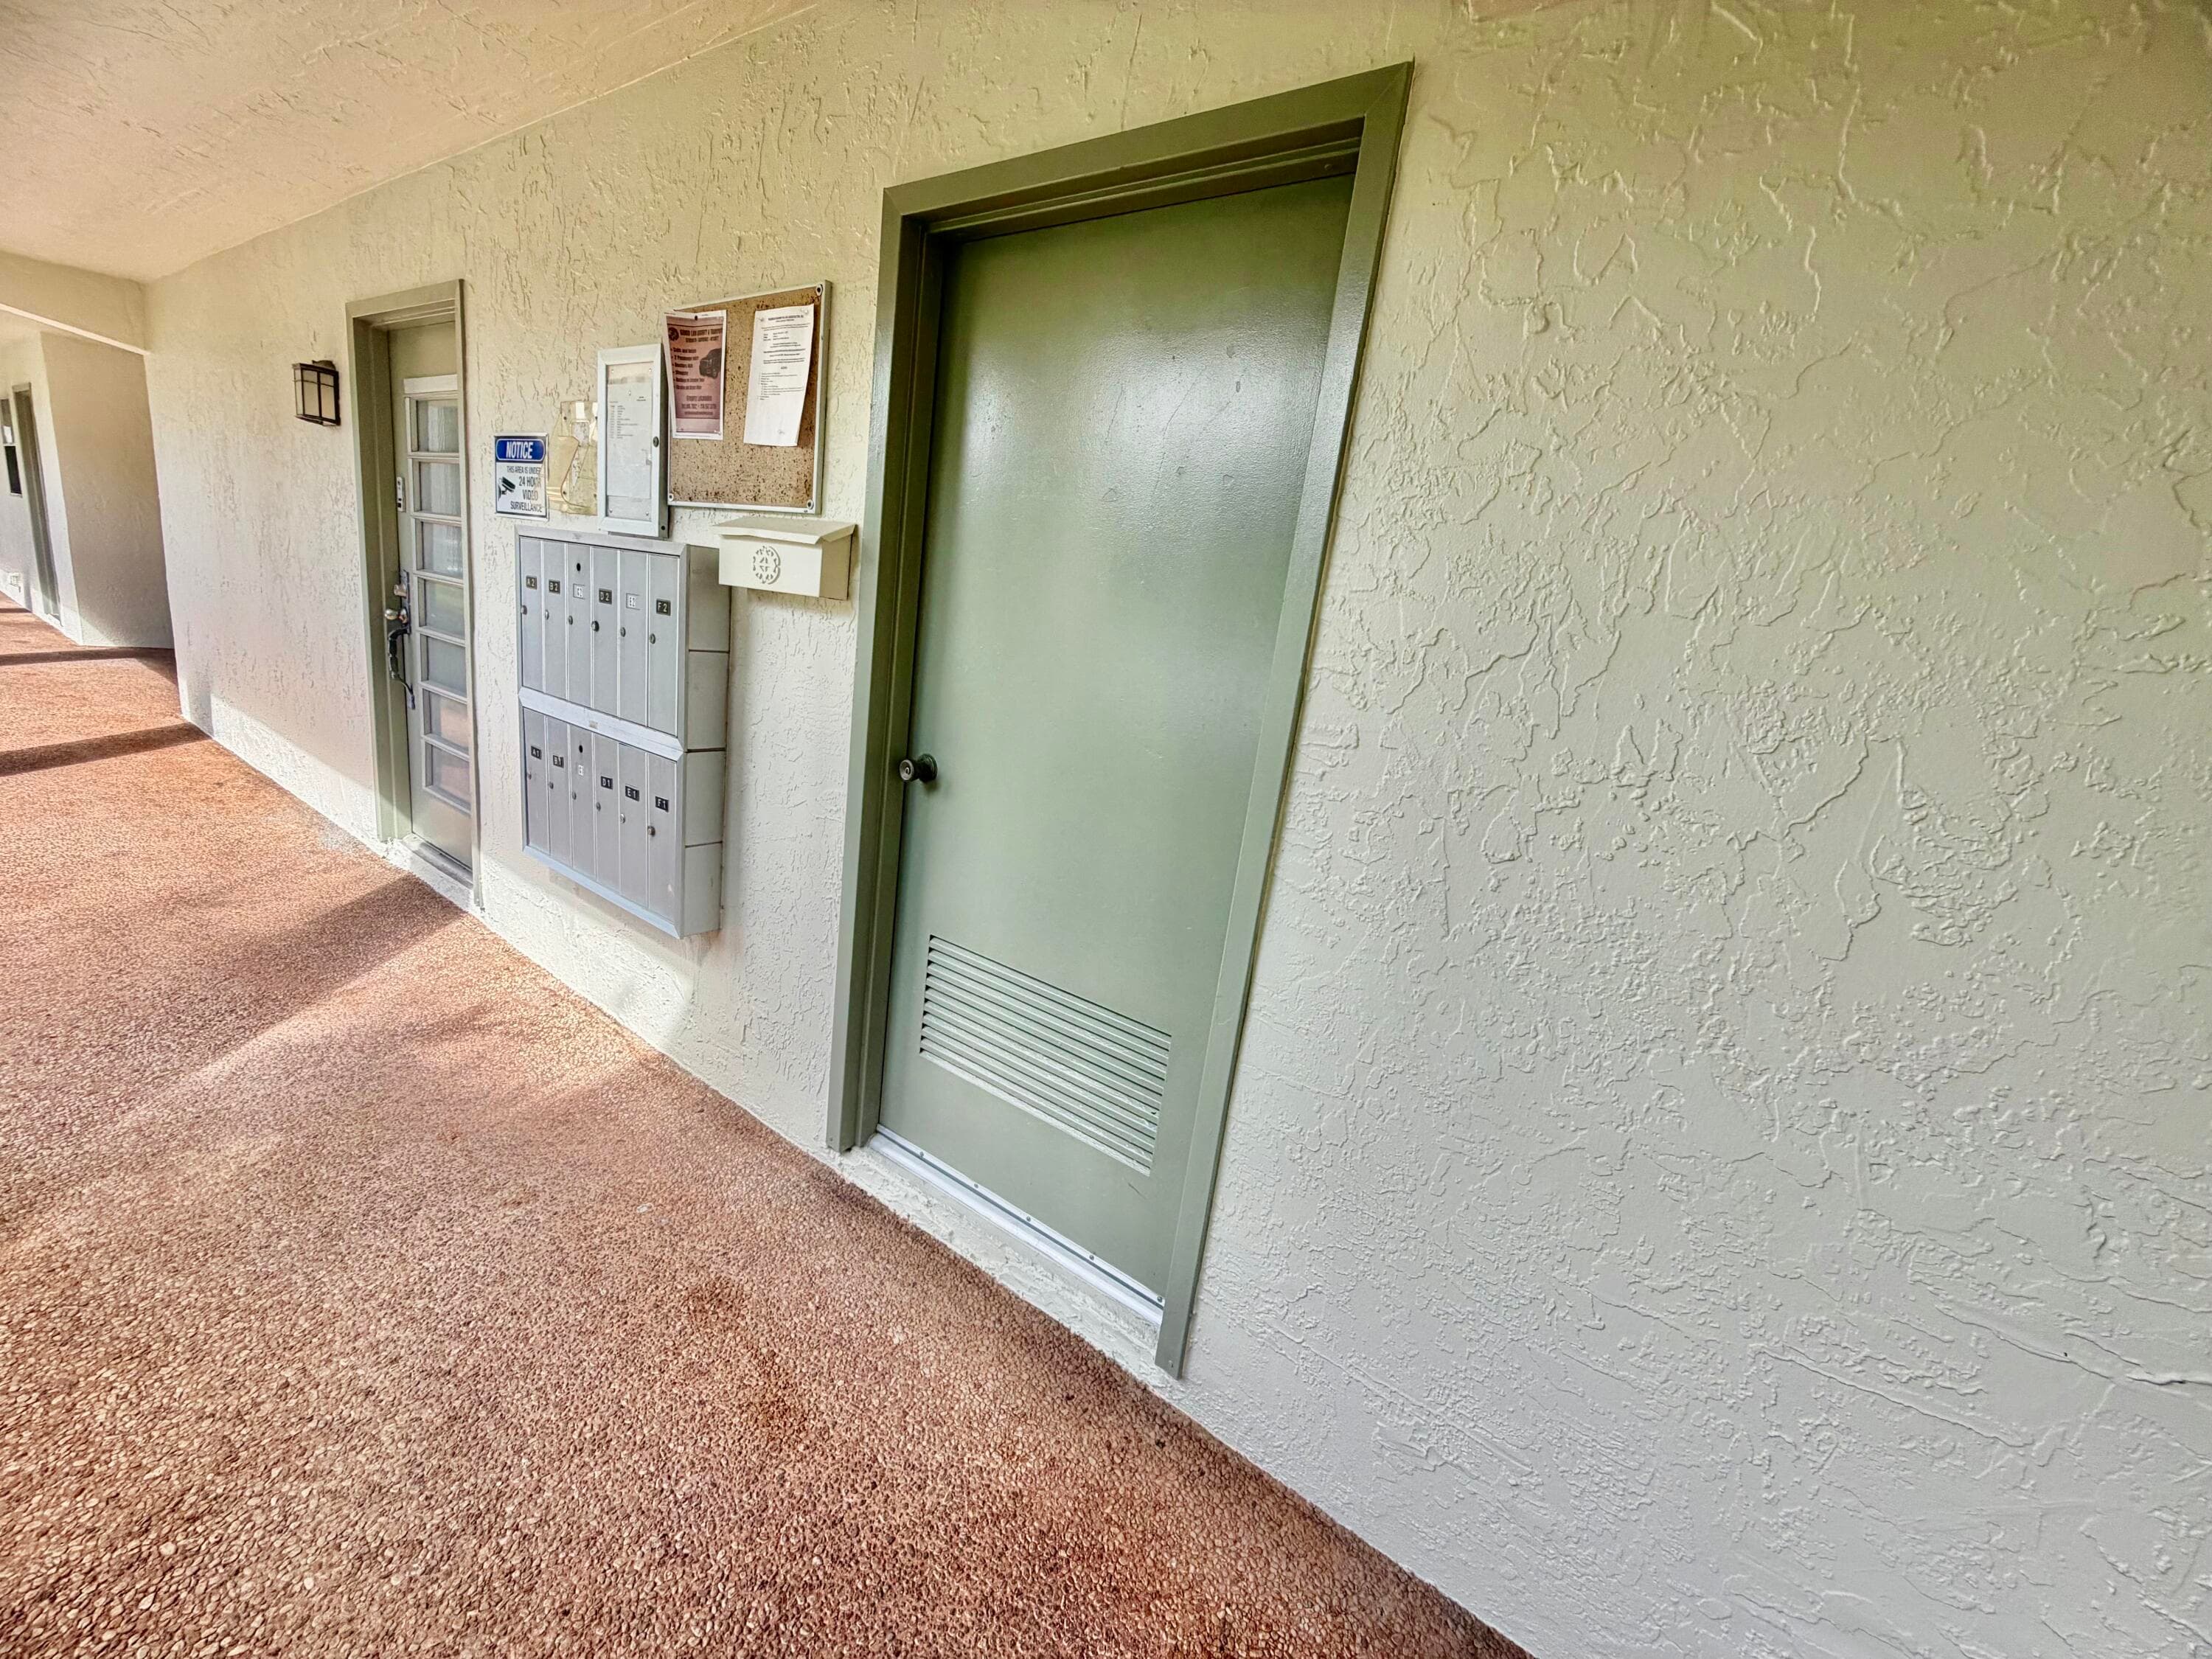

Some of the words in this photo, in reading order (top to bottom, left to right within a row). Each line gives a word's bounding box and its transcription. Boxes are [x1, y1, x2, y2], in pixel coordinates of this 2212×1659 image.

[506, 442, 533, 459] NOTICE
[507, 465, 515, 473] THIS
[515, 466, 524, 474] AREA
[529, 467, 541, 475] UNDER
[518, 476, 526, 487] 24
[526, 477, 541, 488] HOUR
[522, 489, 538, 501] VIDEO
[510, 501, 542, 512] SURVEILLANCE
[526, 578, 535, 587] A2
[549, 582, 559, 591] B2
[599, 591, 610, 602] D2
[657, 601, 667, 613] F2
[532, 748, 540, 757] A1
[602, 778, 611, 787] D1
[626, 787, 636, 799] E1
[657, 799, 667, 810] F1
